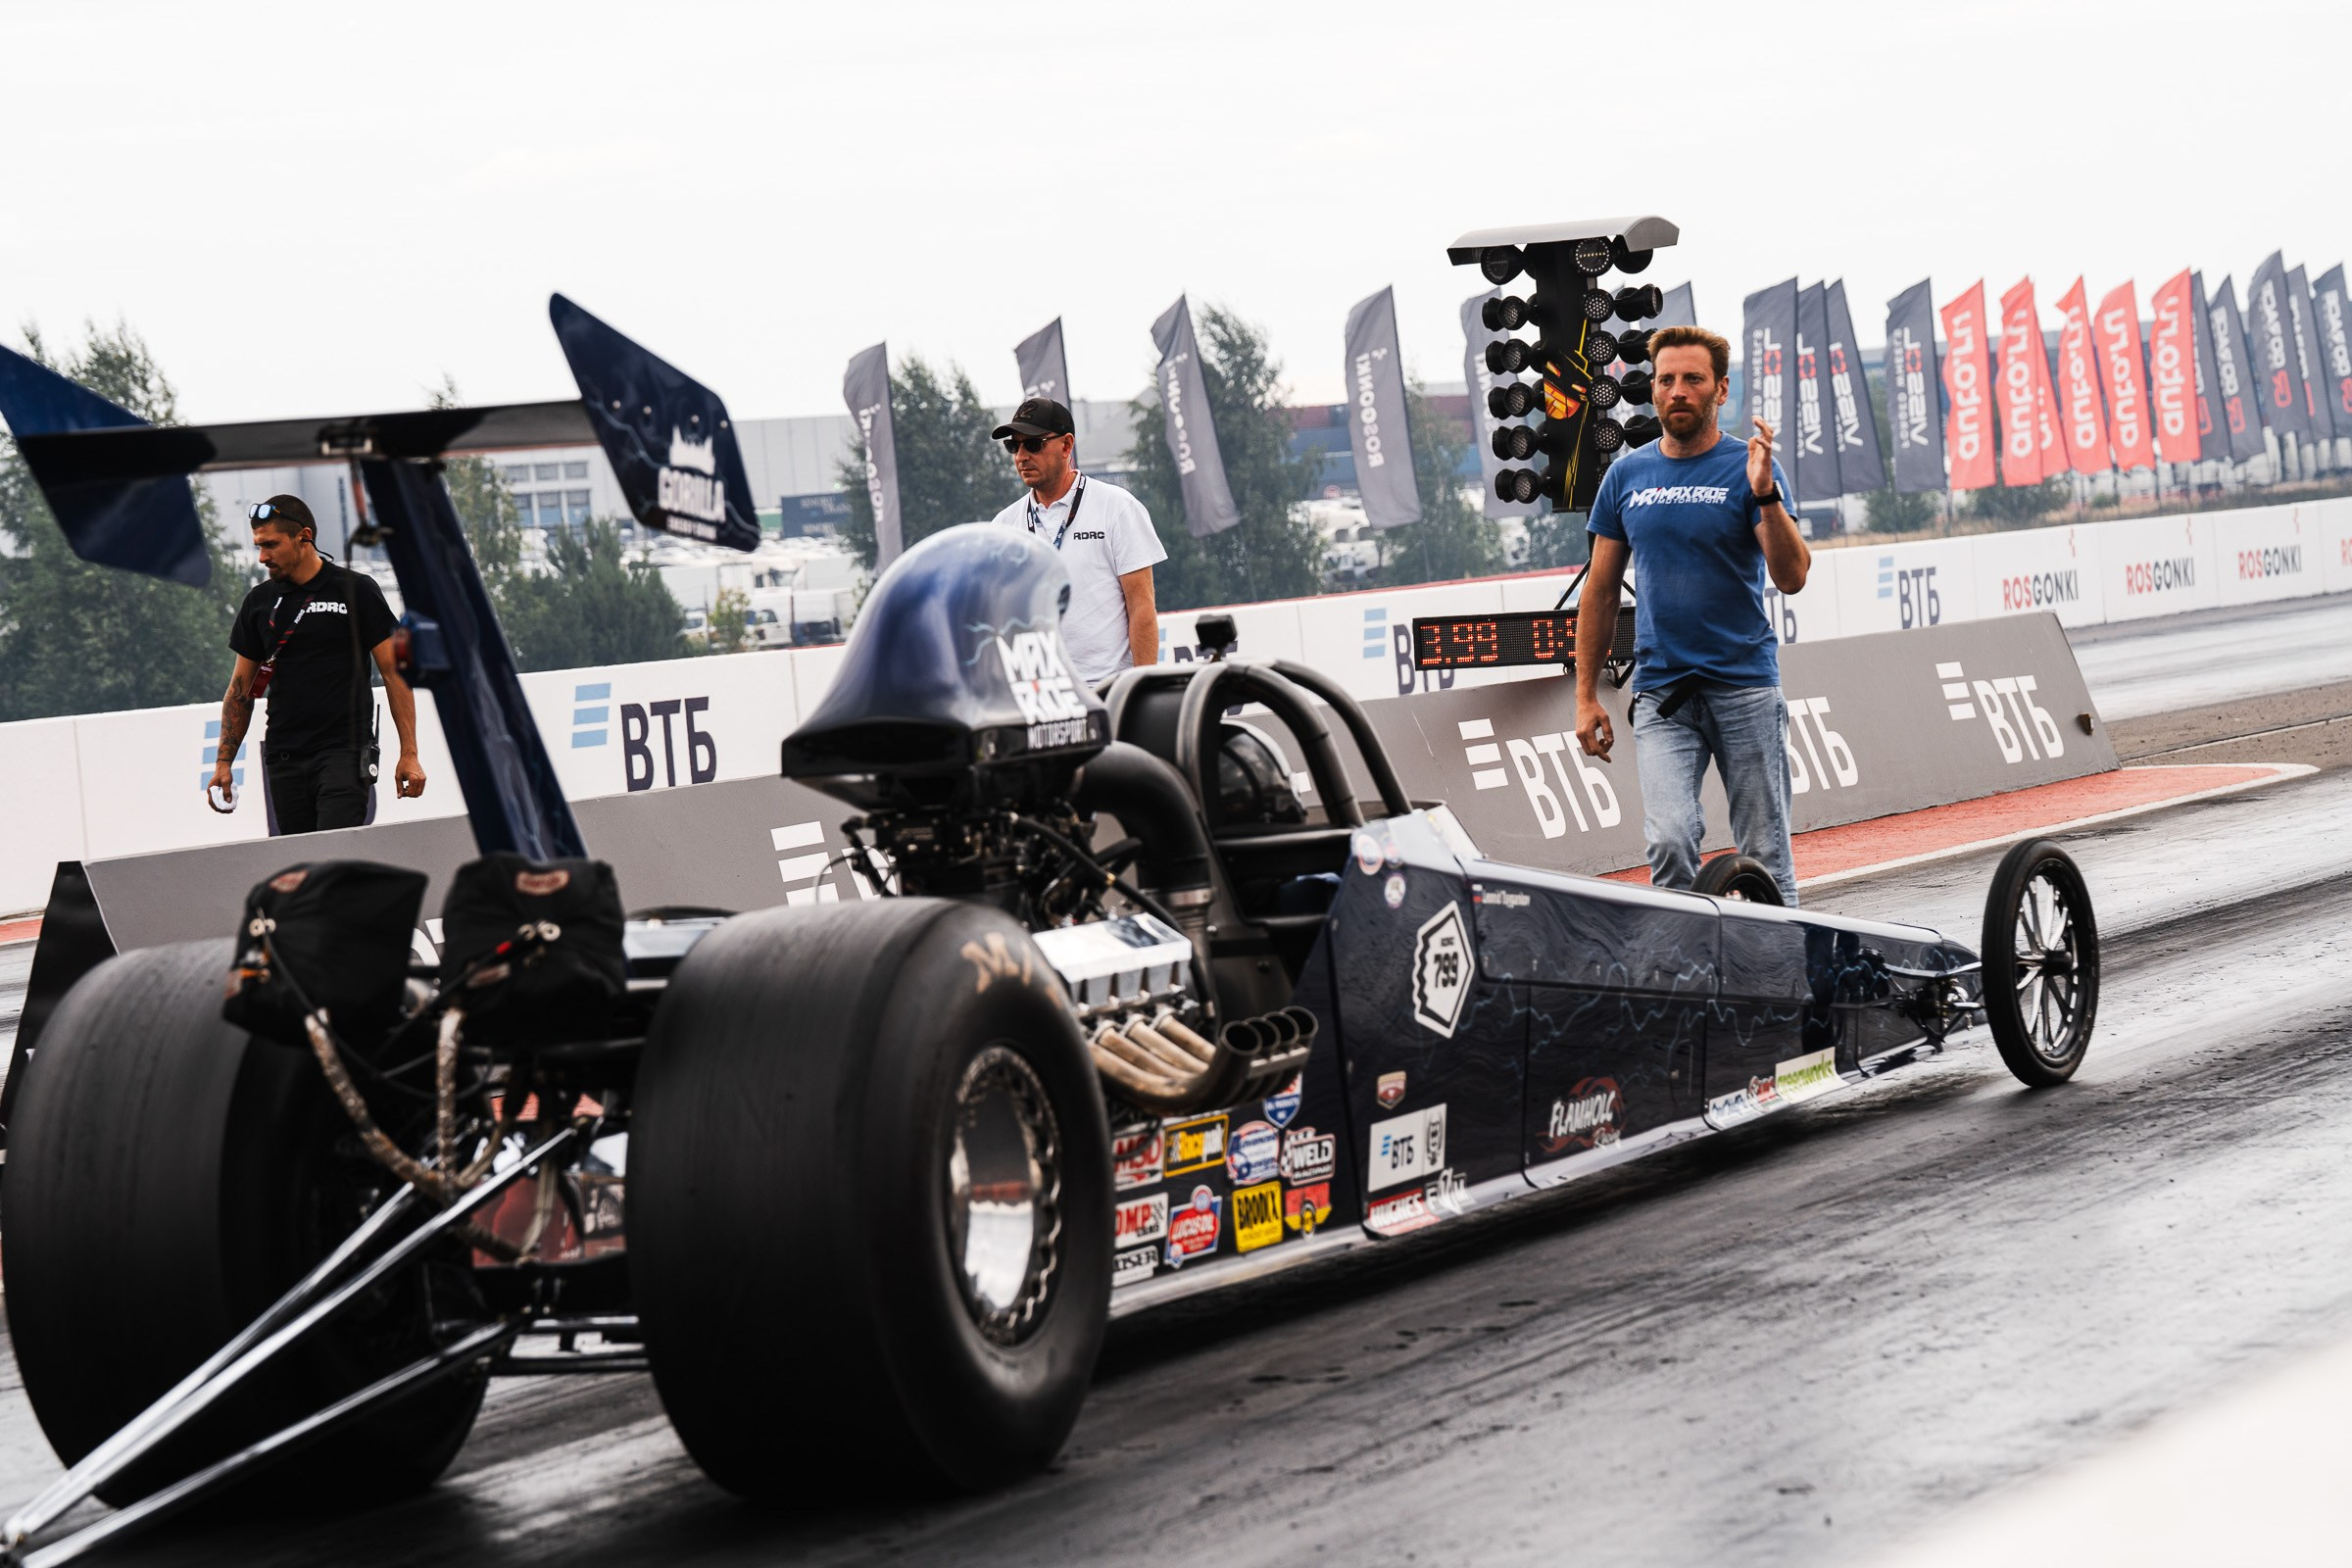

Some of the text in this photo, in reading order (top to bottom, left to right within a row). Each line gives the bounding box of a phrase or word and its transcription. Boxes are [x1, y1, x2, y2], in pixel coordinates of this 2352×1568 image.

[1073, 530, 1105, 540] RDRC
[2126, 558, 2194, 595] ROSGONKI
[2238, 545, 2302, 580] ROSGONKI
[1899, 566, 1940, 630] ВТБ
[2002, 570, 2079, 611] ROSGONKI
[1765, 588, 1796, 644] ТБ
[996, 630, 1070, 684] MAX
[1421, 622, 1498, 665] 3.99
[1027, 718, 1087, 750] MOTORSPORT
[1972, 674, 2064, 764] ВТБ
[620, 696, 717, 792] ВТБ
[1505, 730, 1621, 840] ВТБ
[1434, 952, 1458, 989] 799
[1293, 1140, 1333, 1169] WELD
[1392, 1135, 1414, 1169] ВТБ
[1115, 1203, 1152, 1237] OMP
[1237, 1191, 1279, 1230] BRODIX
[1113, 1250, 1158, 1272] OSER
